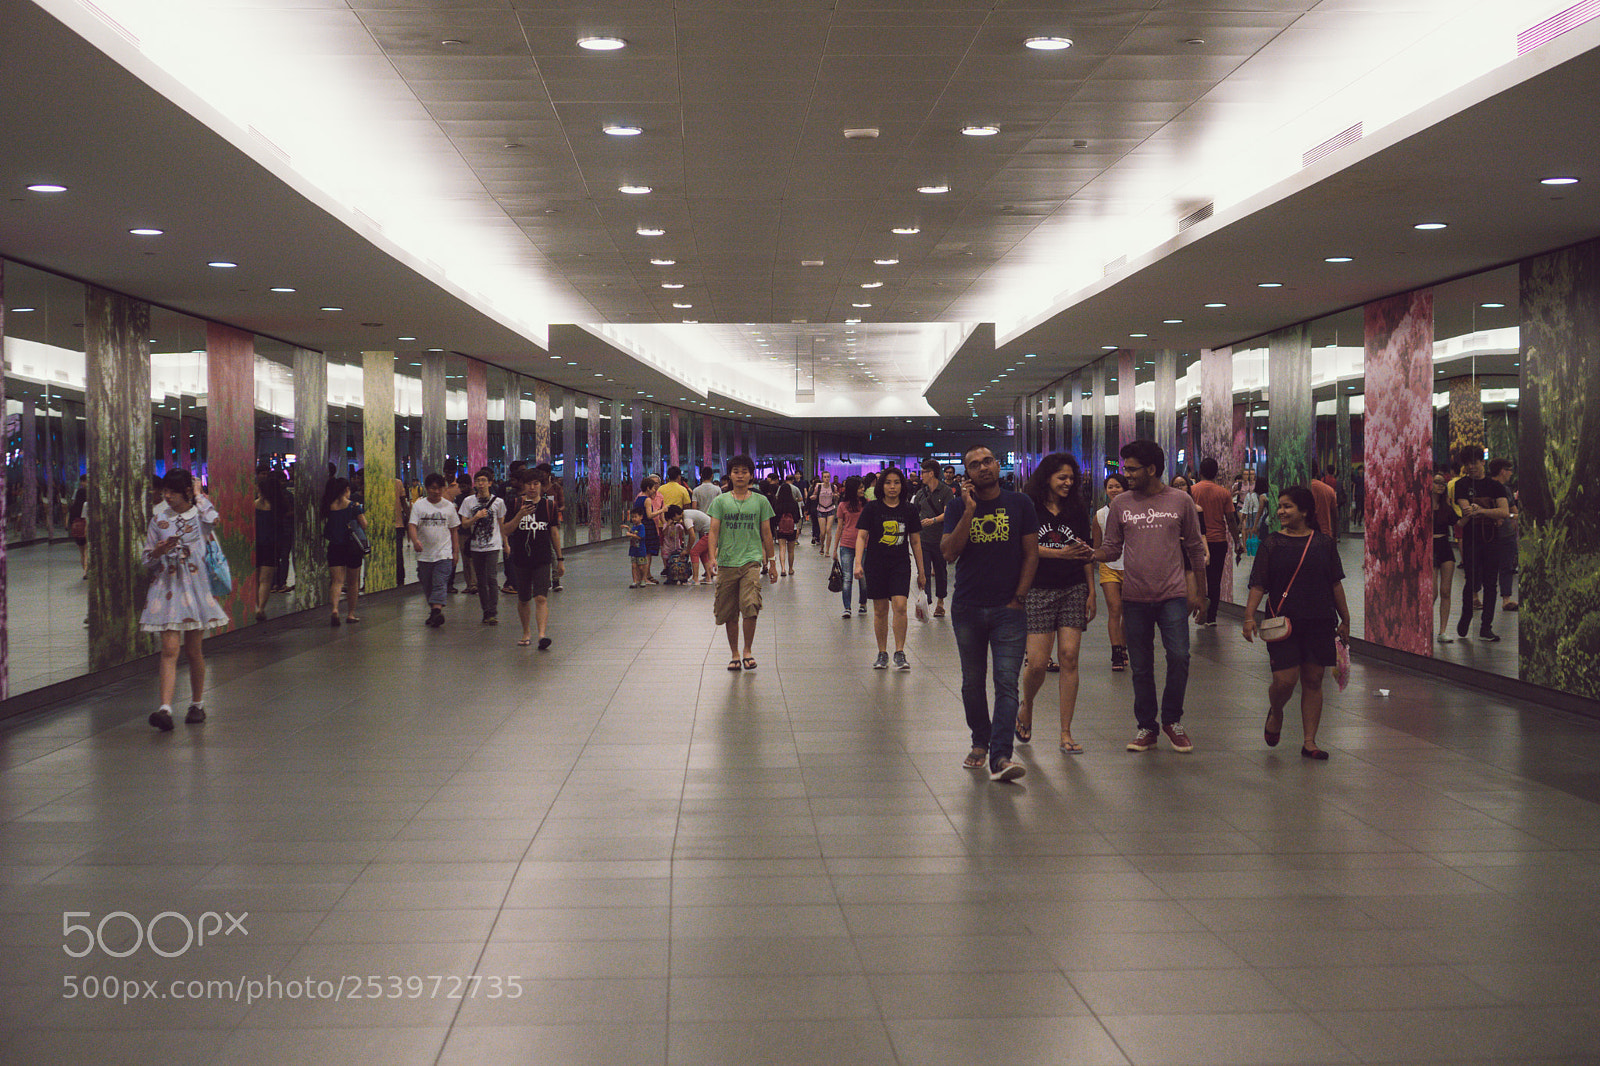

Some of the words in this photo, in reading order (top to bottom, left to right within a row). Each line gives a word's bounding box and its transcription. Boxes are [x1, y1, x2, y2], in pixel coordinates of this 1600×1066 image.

[1122, 509, 1146, 524] Pepe
[1146, 508, 1178, 523] Jeans
[518, 521, 549, 531] GLORY
